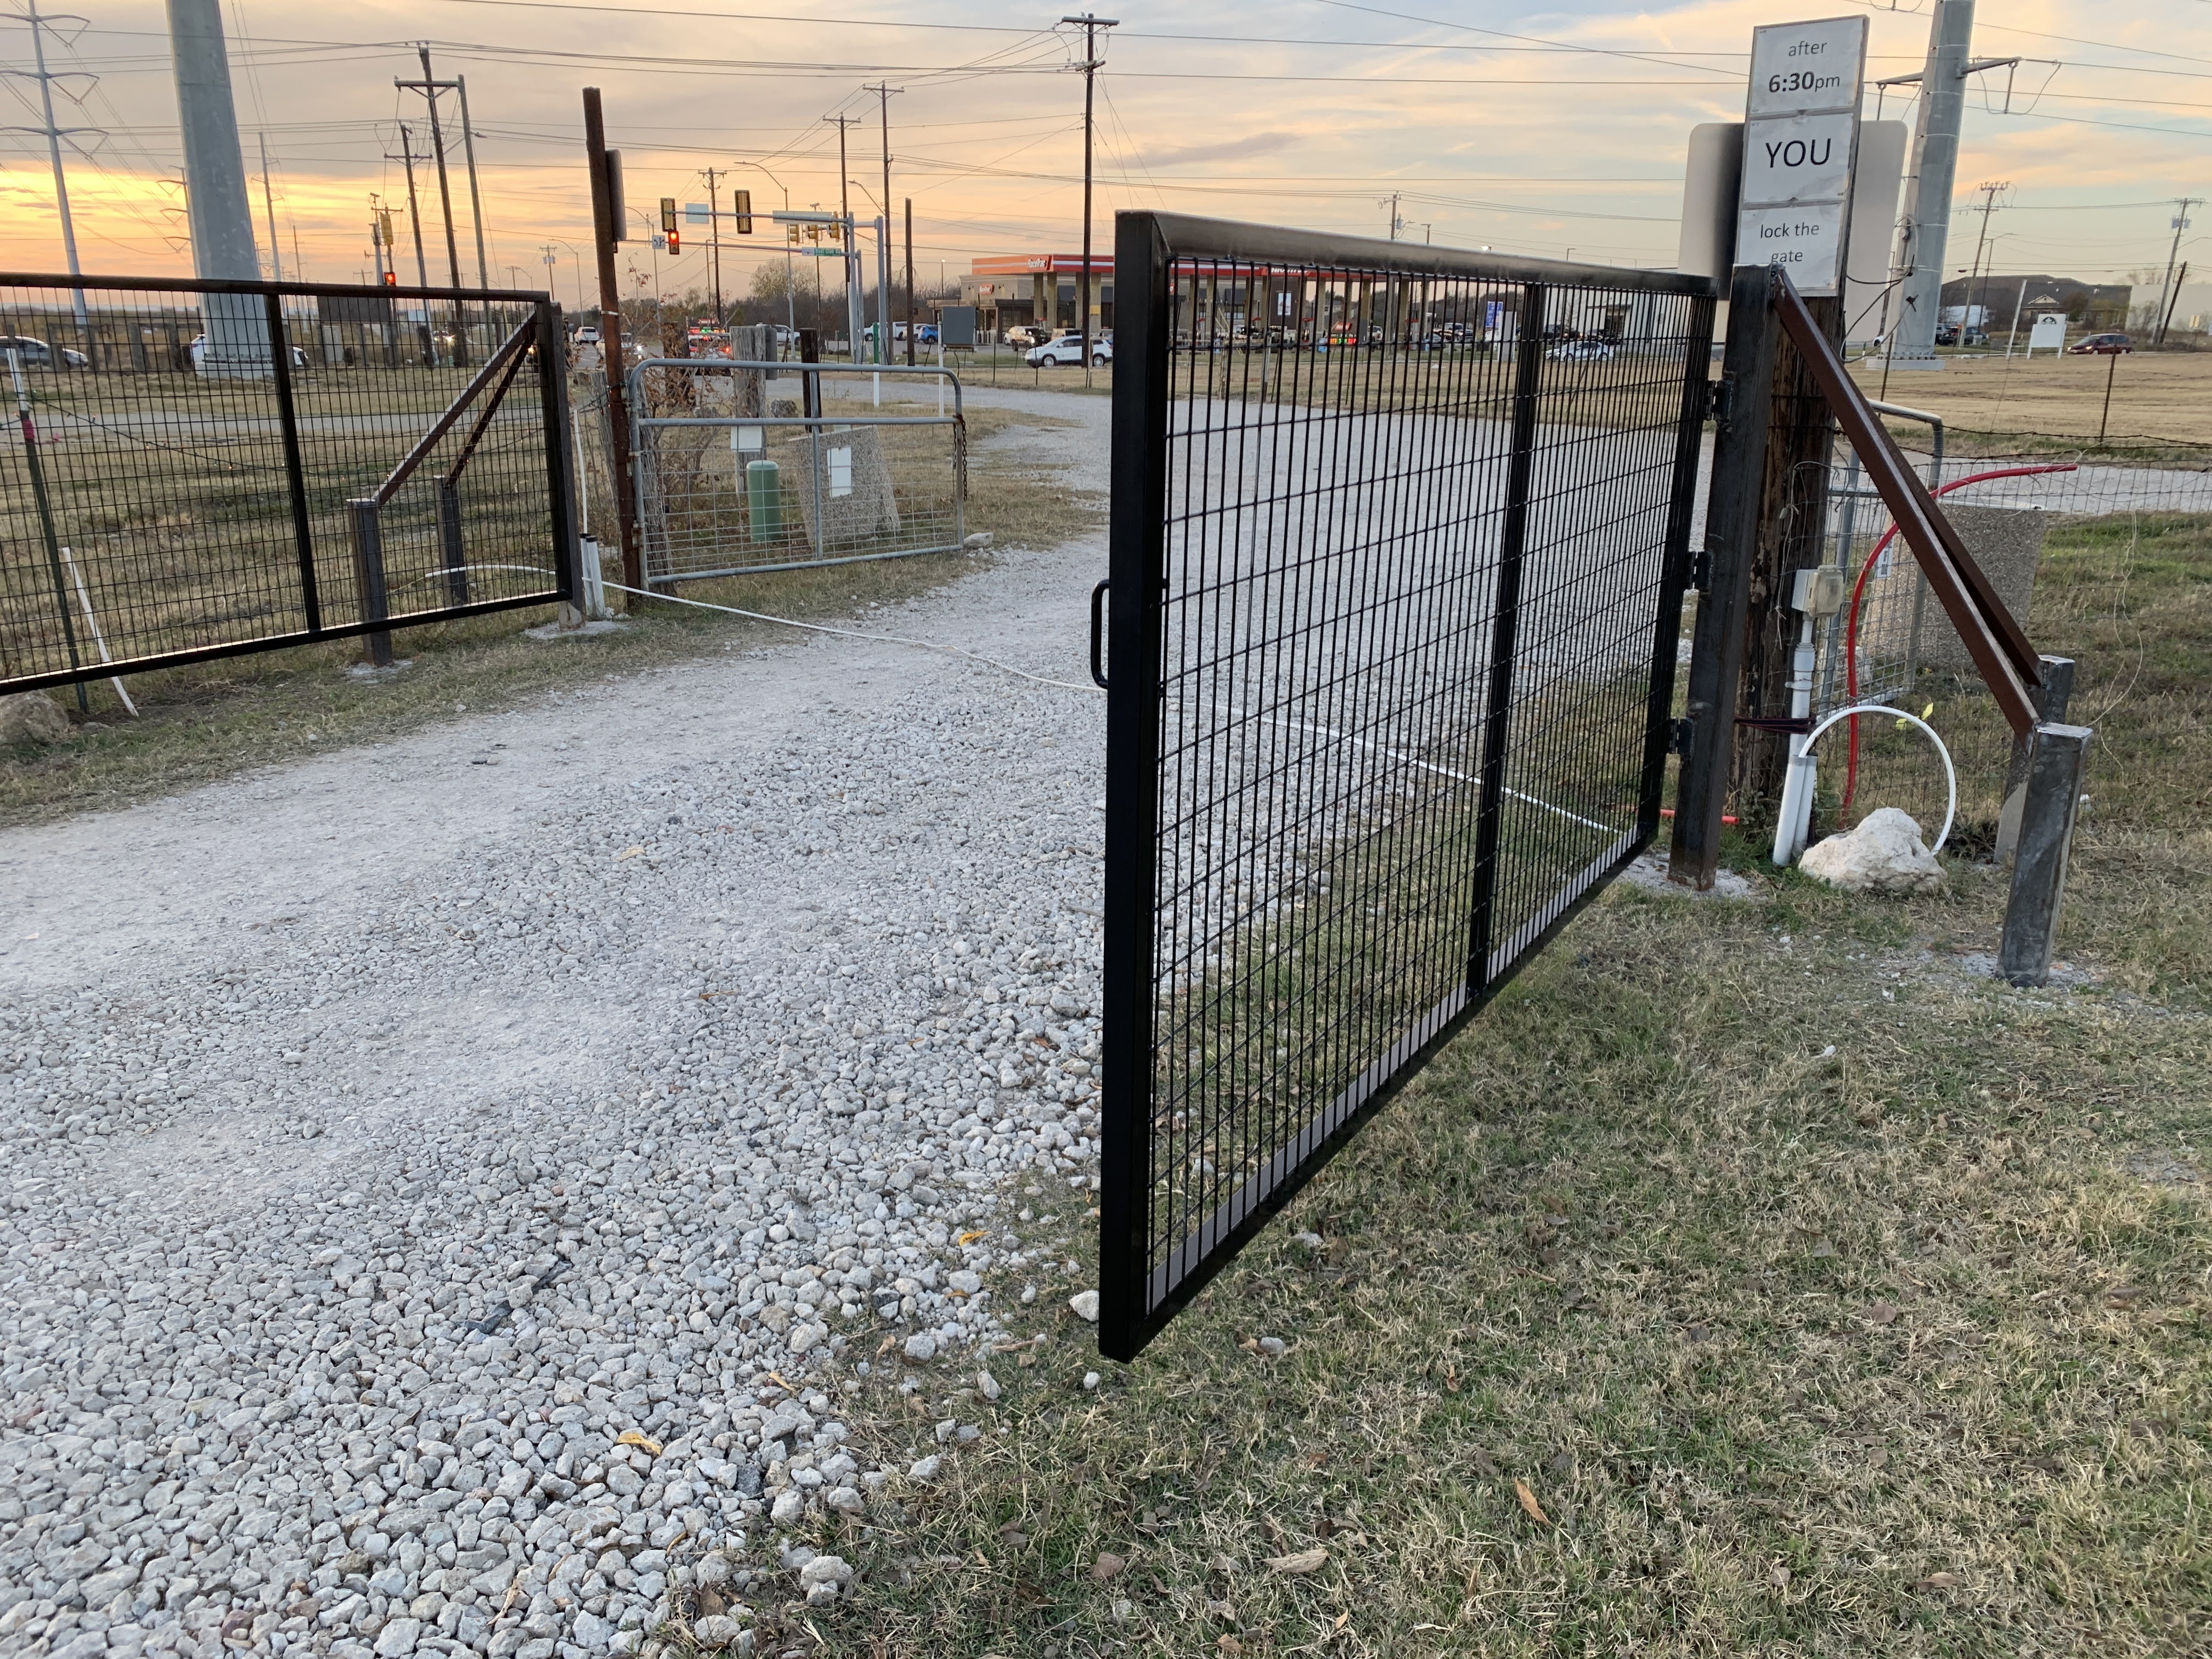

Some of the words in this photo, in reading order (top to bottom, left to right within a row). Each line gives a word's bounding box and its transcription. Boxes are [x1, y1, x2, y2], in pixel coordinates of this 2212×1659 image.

[1788, 41, 1827, 56] after
[1769, 71, 1840, 92] 6:30pm
[1765, 138, 1831, 168] YOU
[1760, 223, 1790, 238] lock
[1795, 222, 1819, 236] the
[1771, 250, 1803, 264] gate
